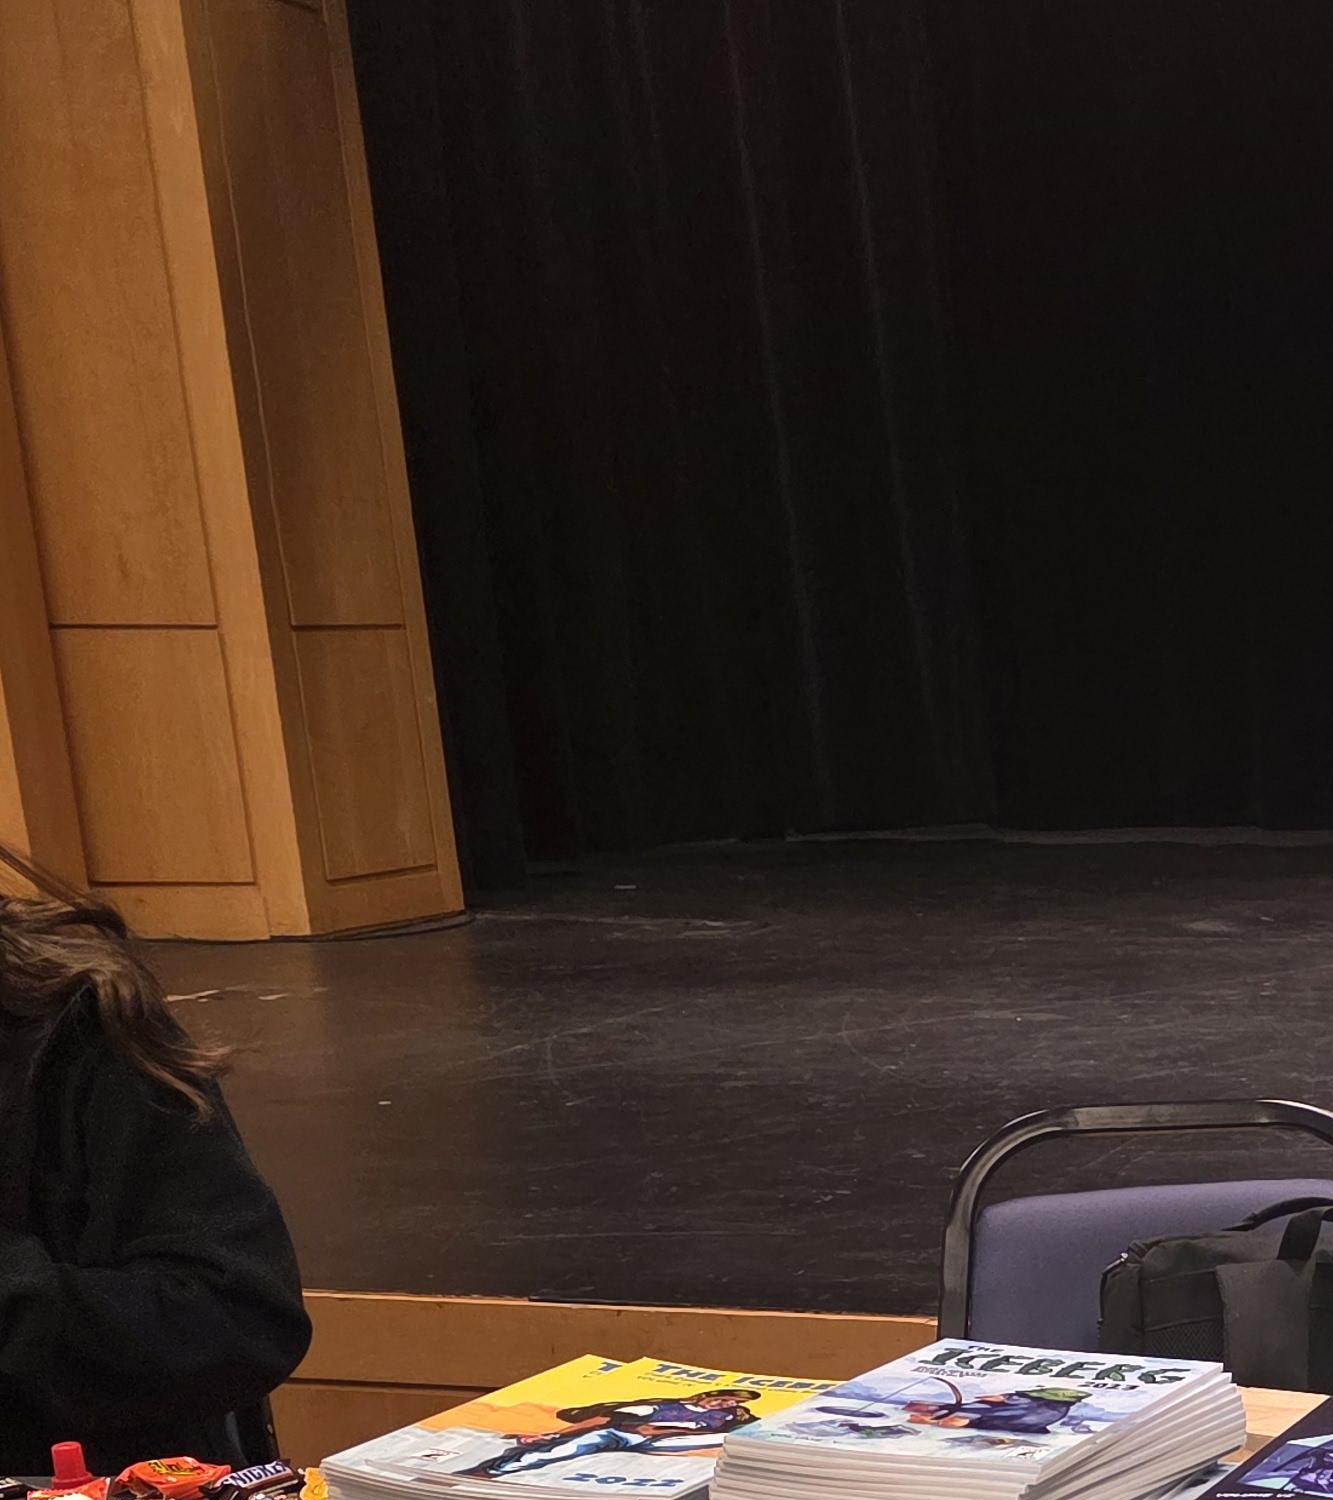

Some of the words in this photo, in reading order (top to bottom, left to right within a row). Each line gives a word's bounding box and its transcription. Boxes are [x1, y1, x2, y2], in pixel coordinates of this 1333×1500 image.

[652, 1363, 726, 1382] THE
[733, 1376, 837, 1391] ICEBE
[917, 1347, 1191, 1385] ICEBERG
[1077, 1380, 1140, 1391] 2023
